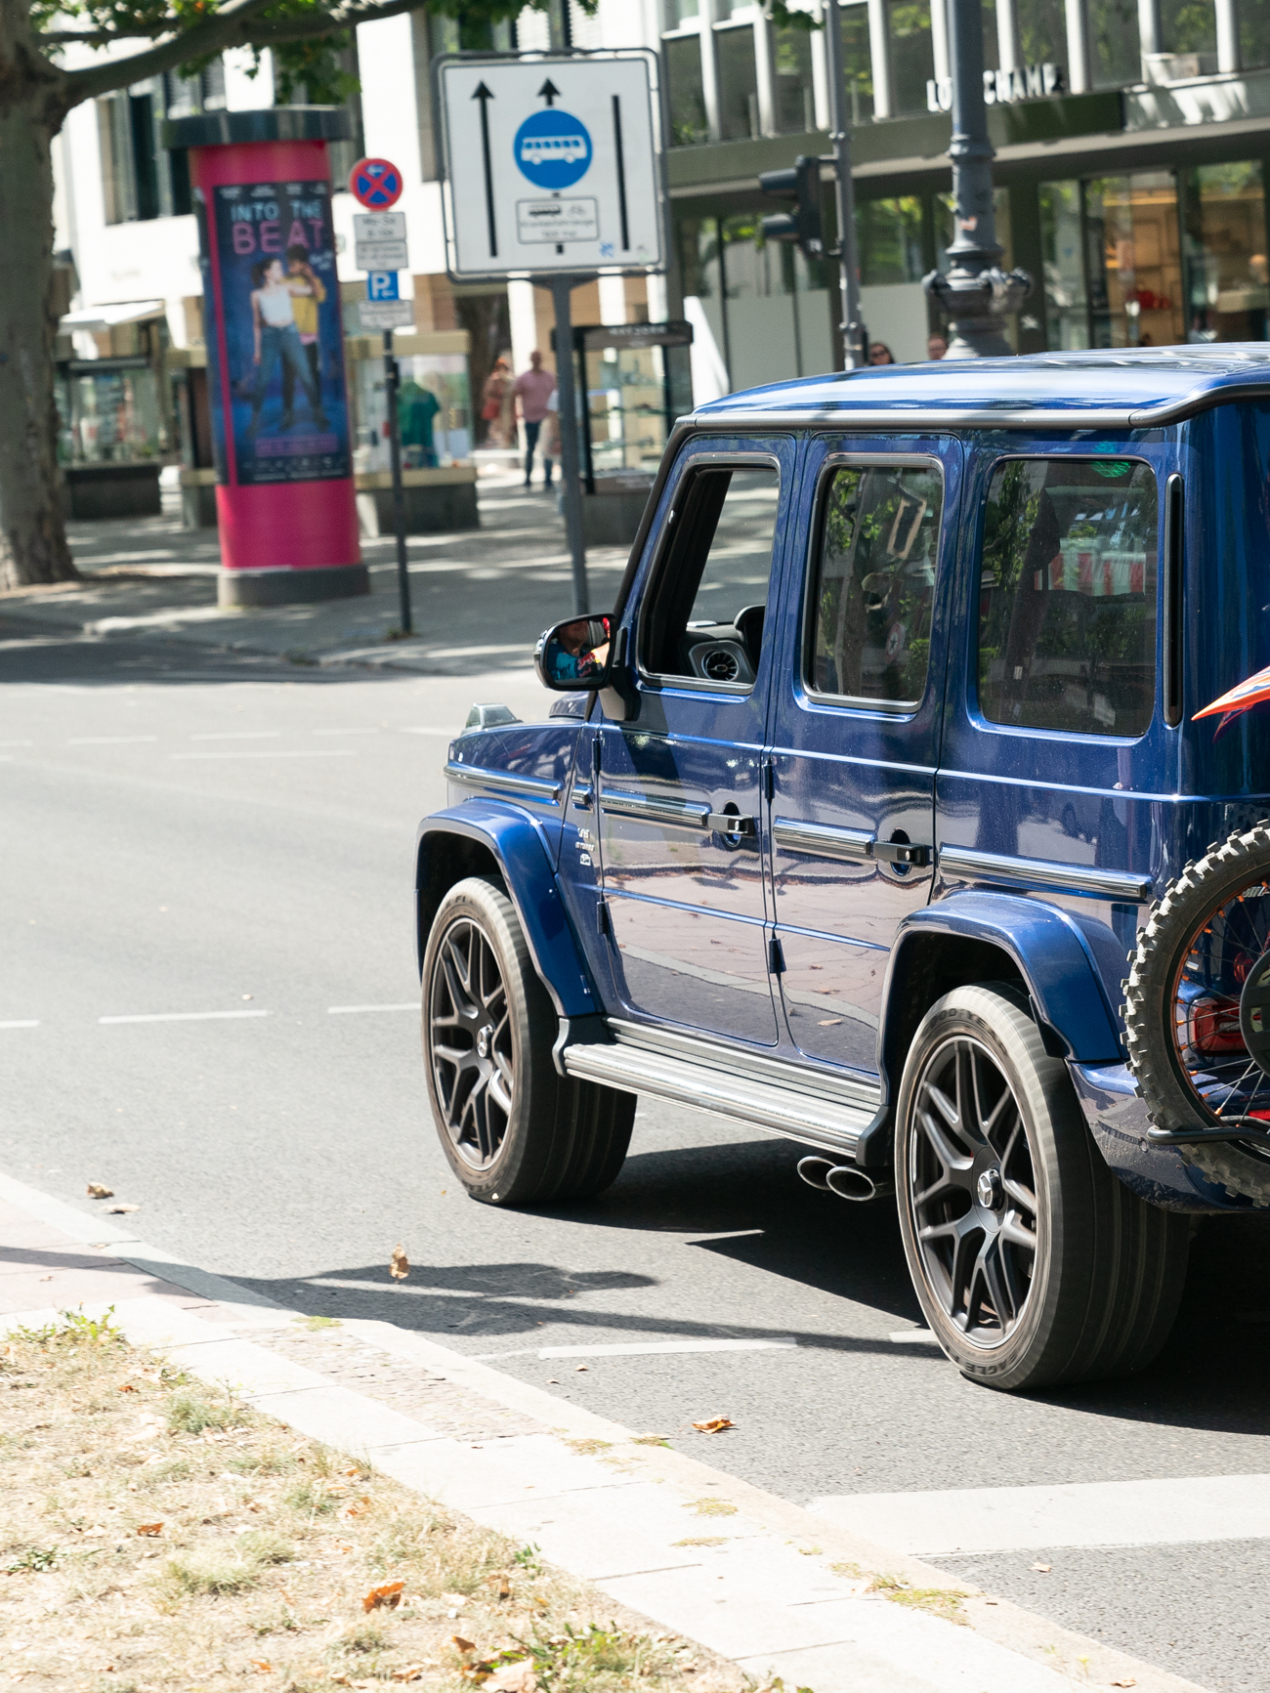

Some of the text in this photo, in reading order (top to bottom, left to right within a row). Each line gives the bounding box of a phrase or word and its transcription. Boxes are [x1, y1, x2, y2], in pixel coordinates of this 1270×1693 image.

[230, 200, 321, 221] INTO THE
[232, 217, 324, 255] BEAT
